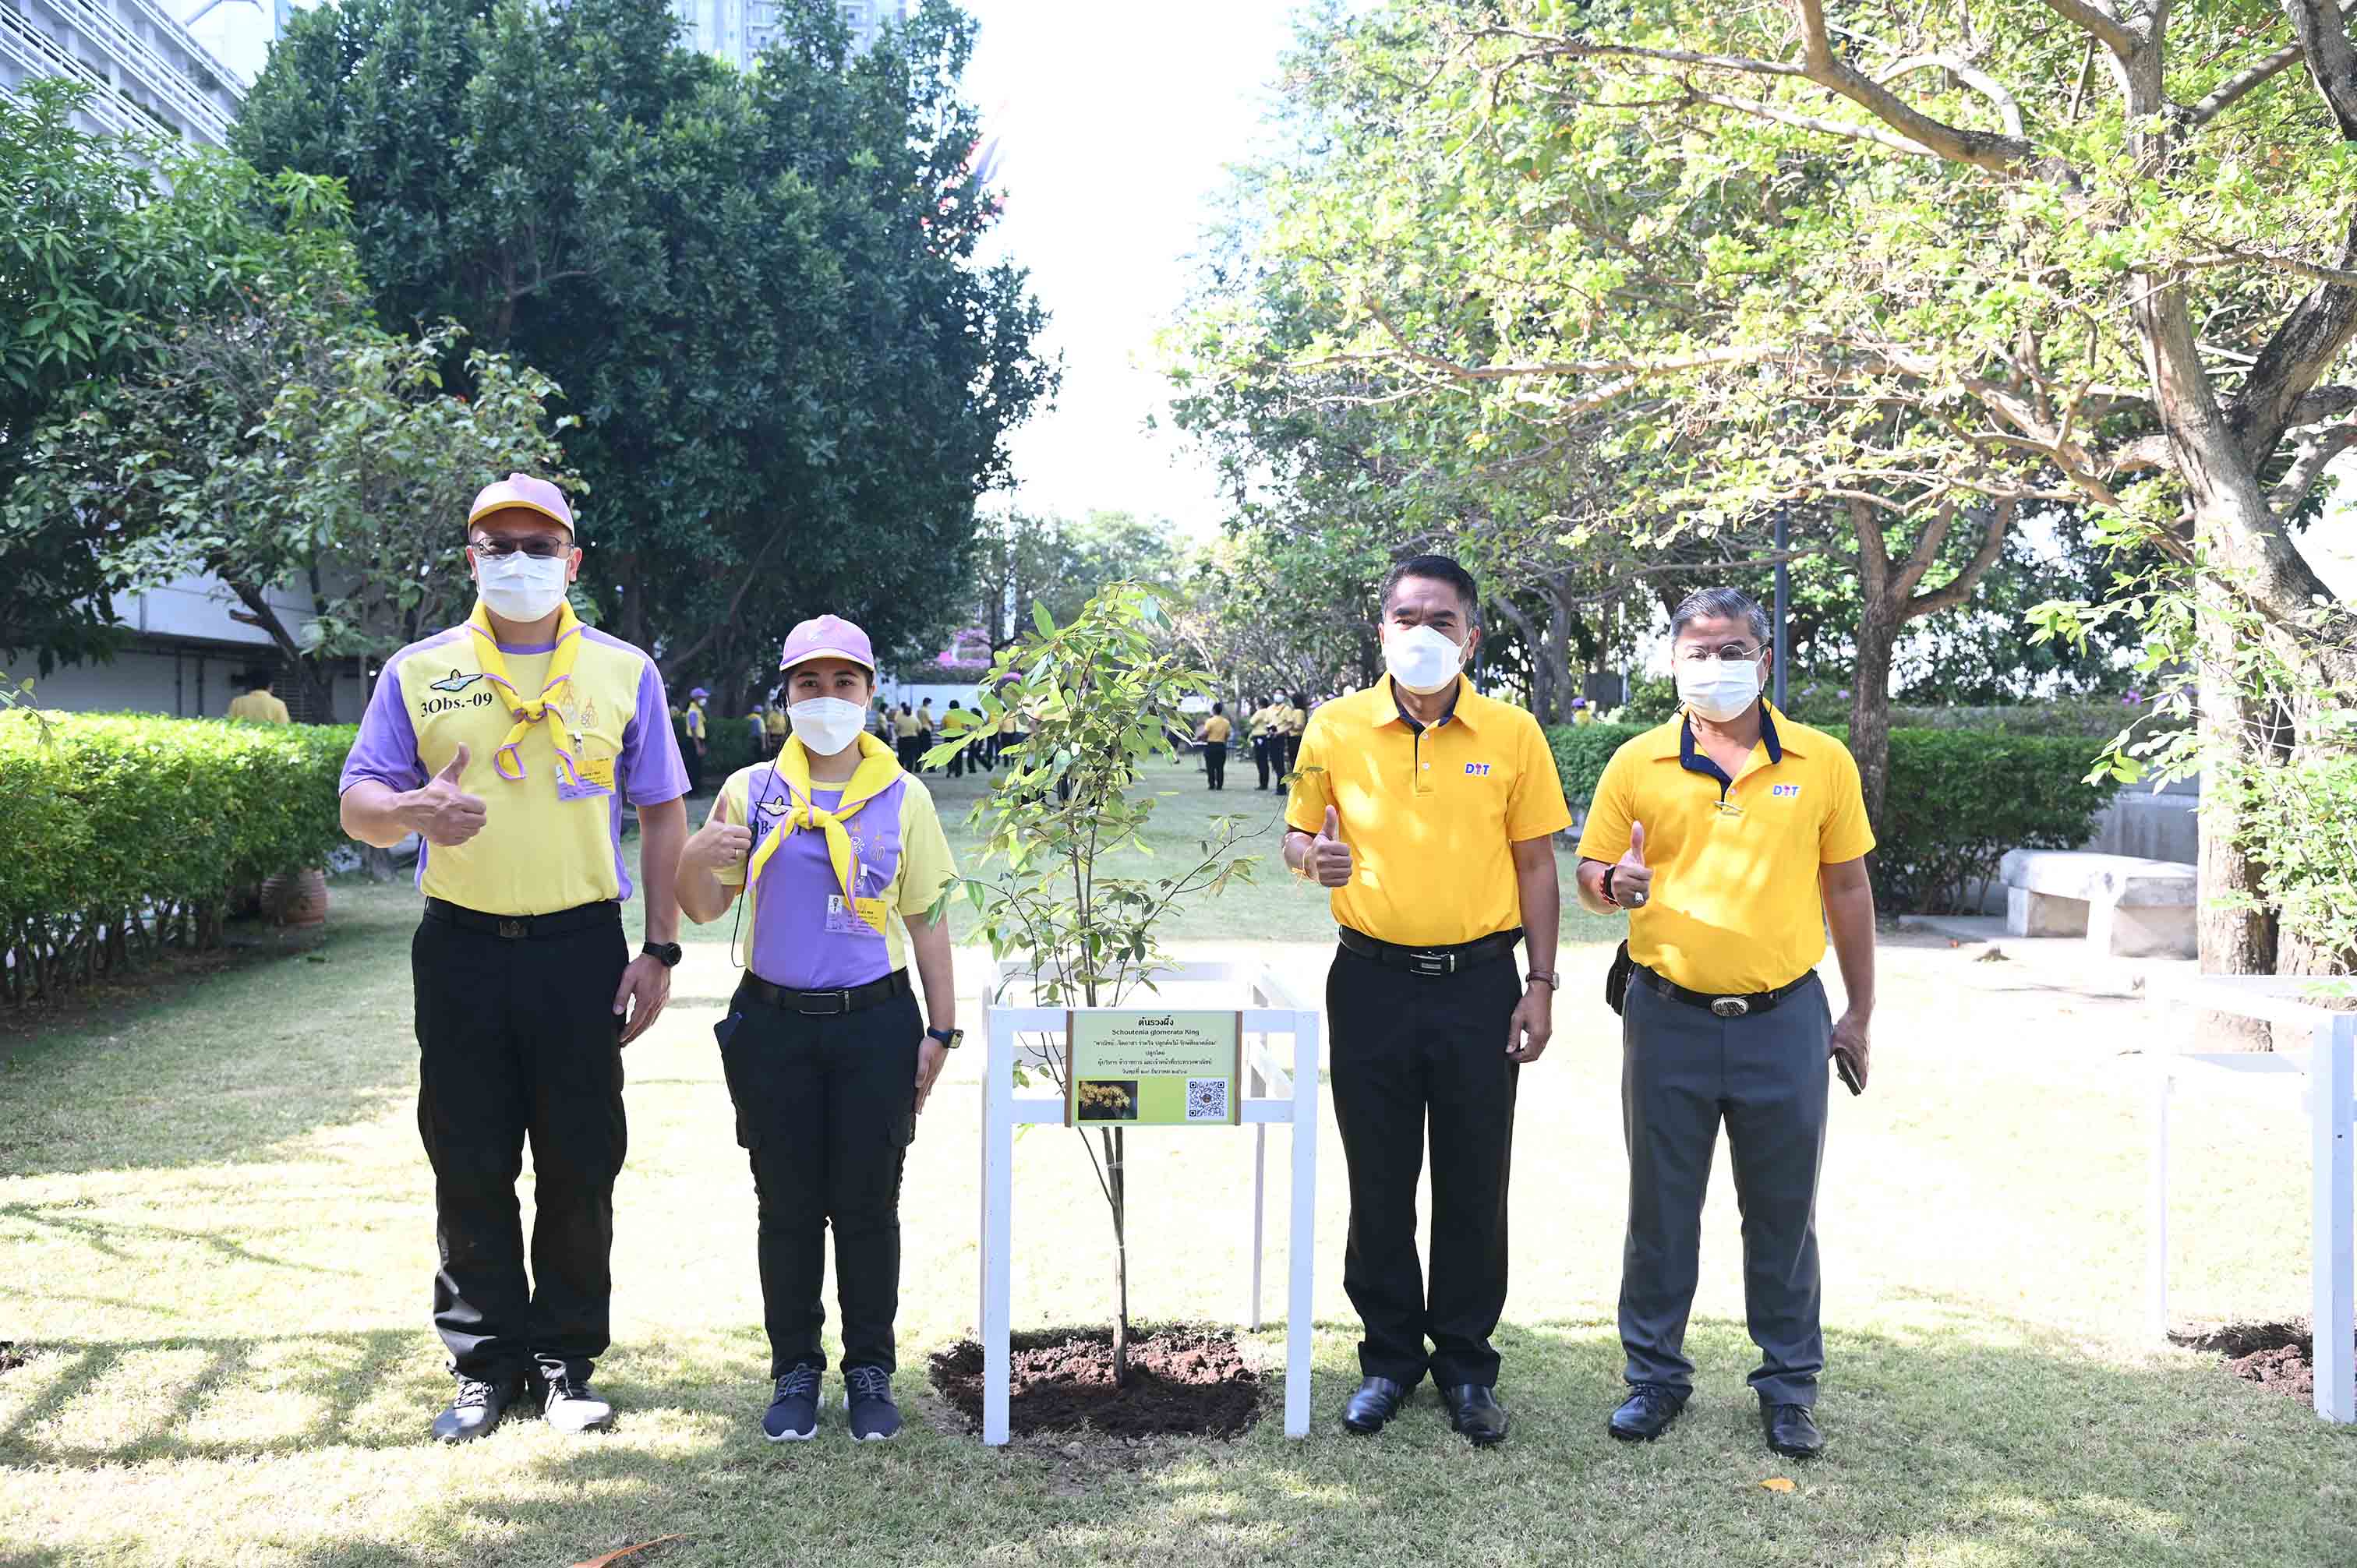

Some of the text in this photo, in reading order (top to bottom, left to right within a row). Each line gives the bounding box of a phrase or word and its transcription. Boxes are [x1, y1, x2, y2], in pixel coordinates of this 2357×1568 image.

[420, 691, 493, 718] 3Obs.-09
[1138, 1015, 1174, 1026] ต้นรวงผึ้ง
